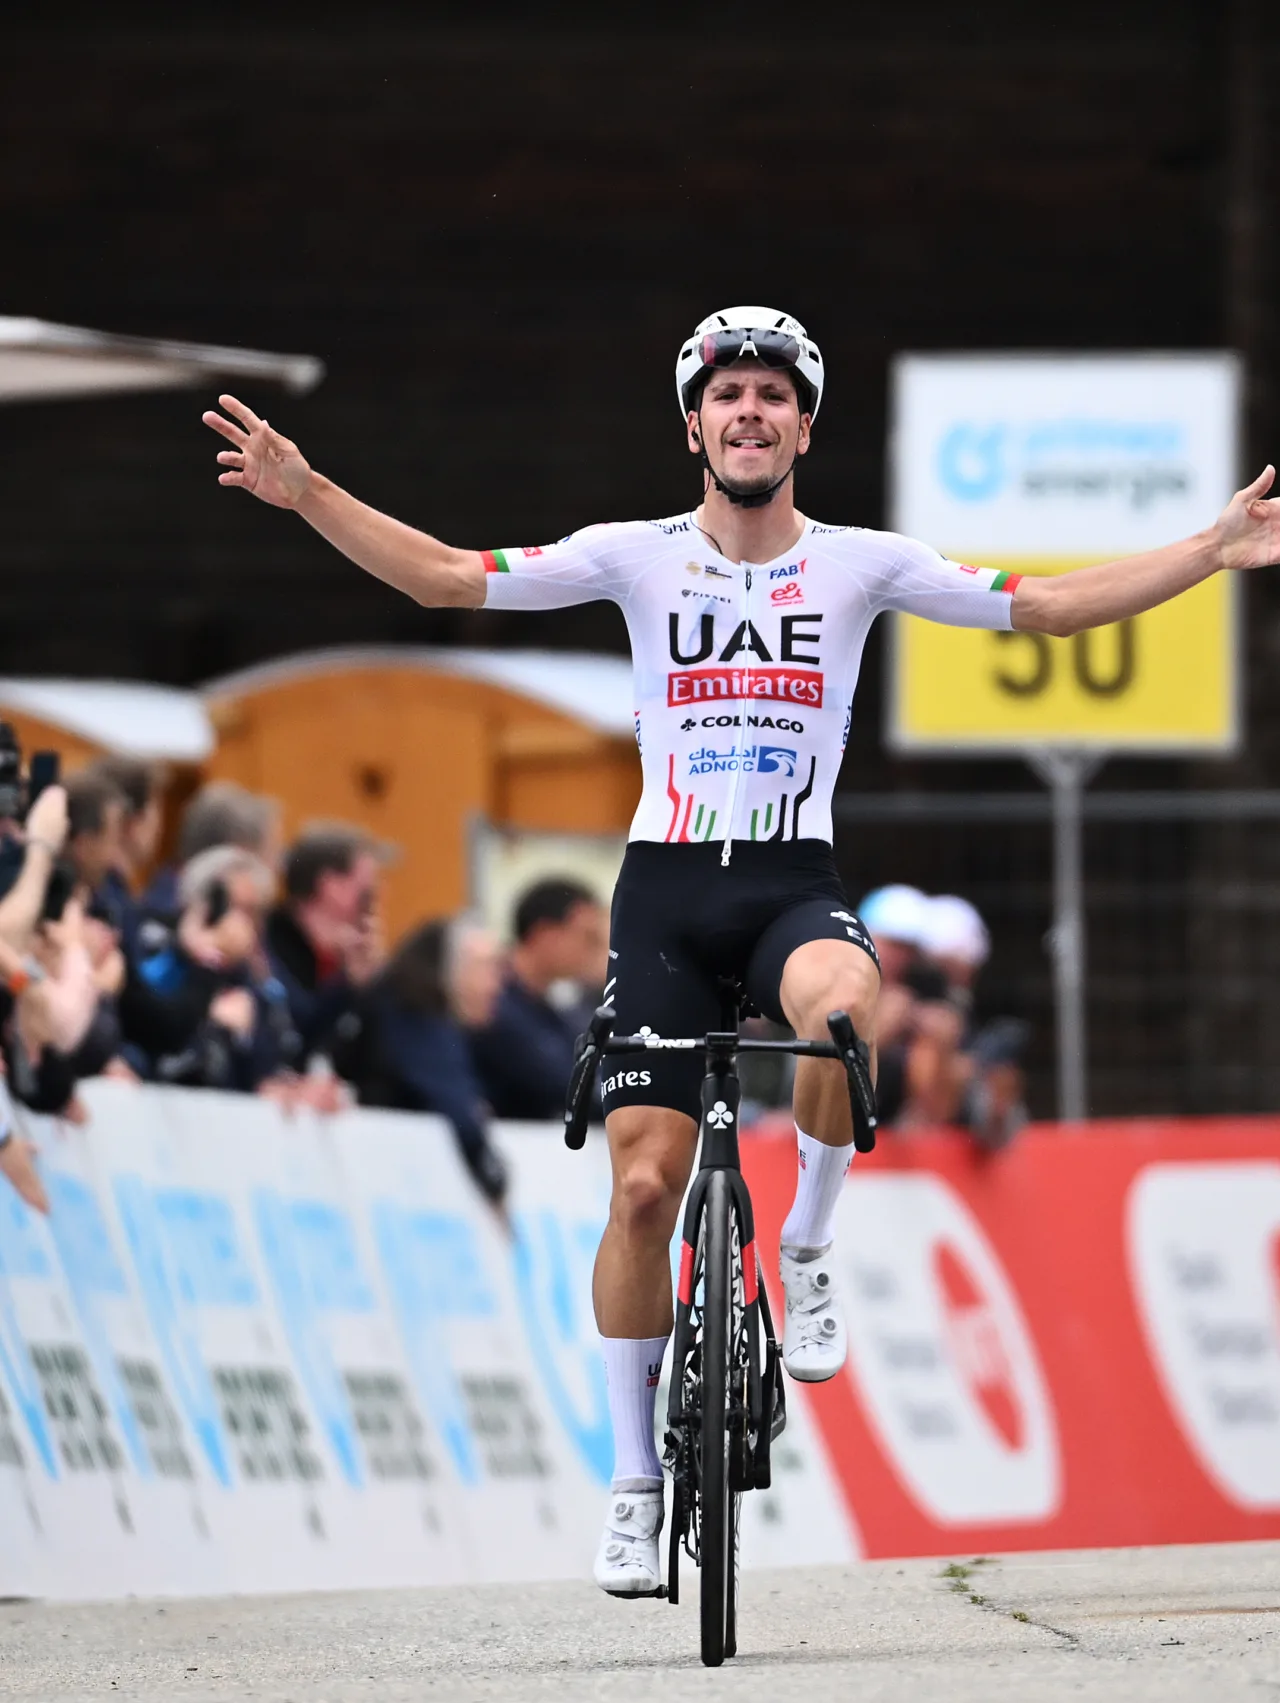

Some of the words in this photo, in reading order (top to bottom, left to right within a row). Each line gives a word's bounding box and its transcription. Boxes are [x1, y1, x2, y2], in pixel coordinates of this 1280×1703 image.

[669, 612, 824, 666] UAE
[672, 671, 820, 702] Emirates
[701, 715, 804, 734] COLNAGO
[689, 761, 755, 776] ADNOC
